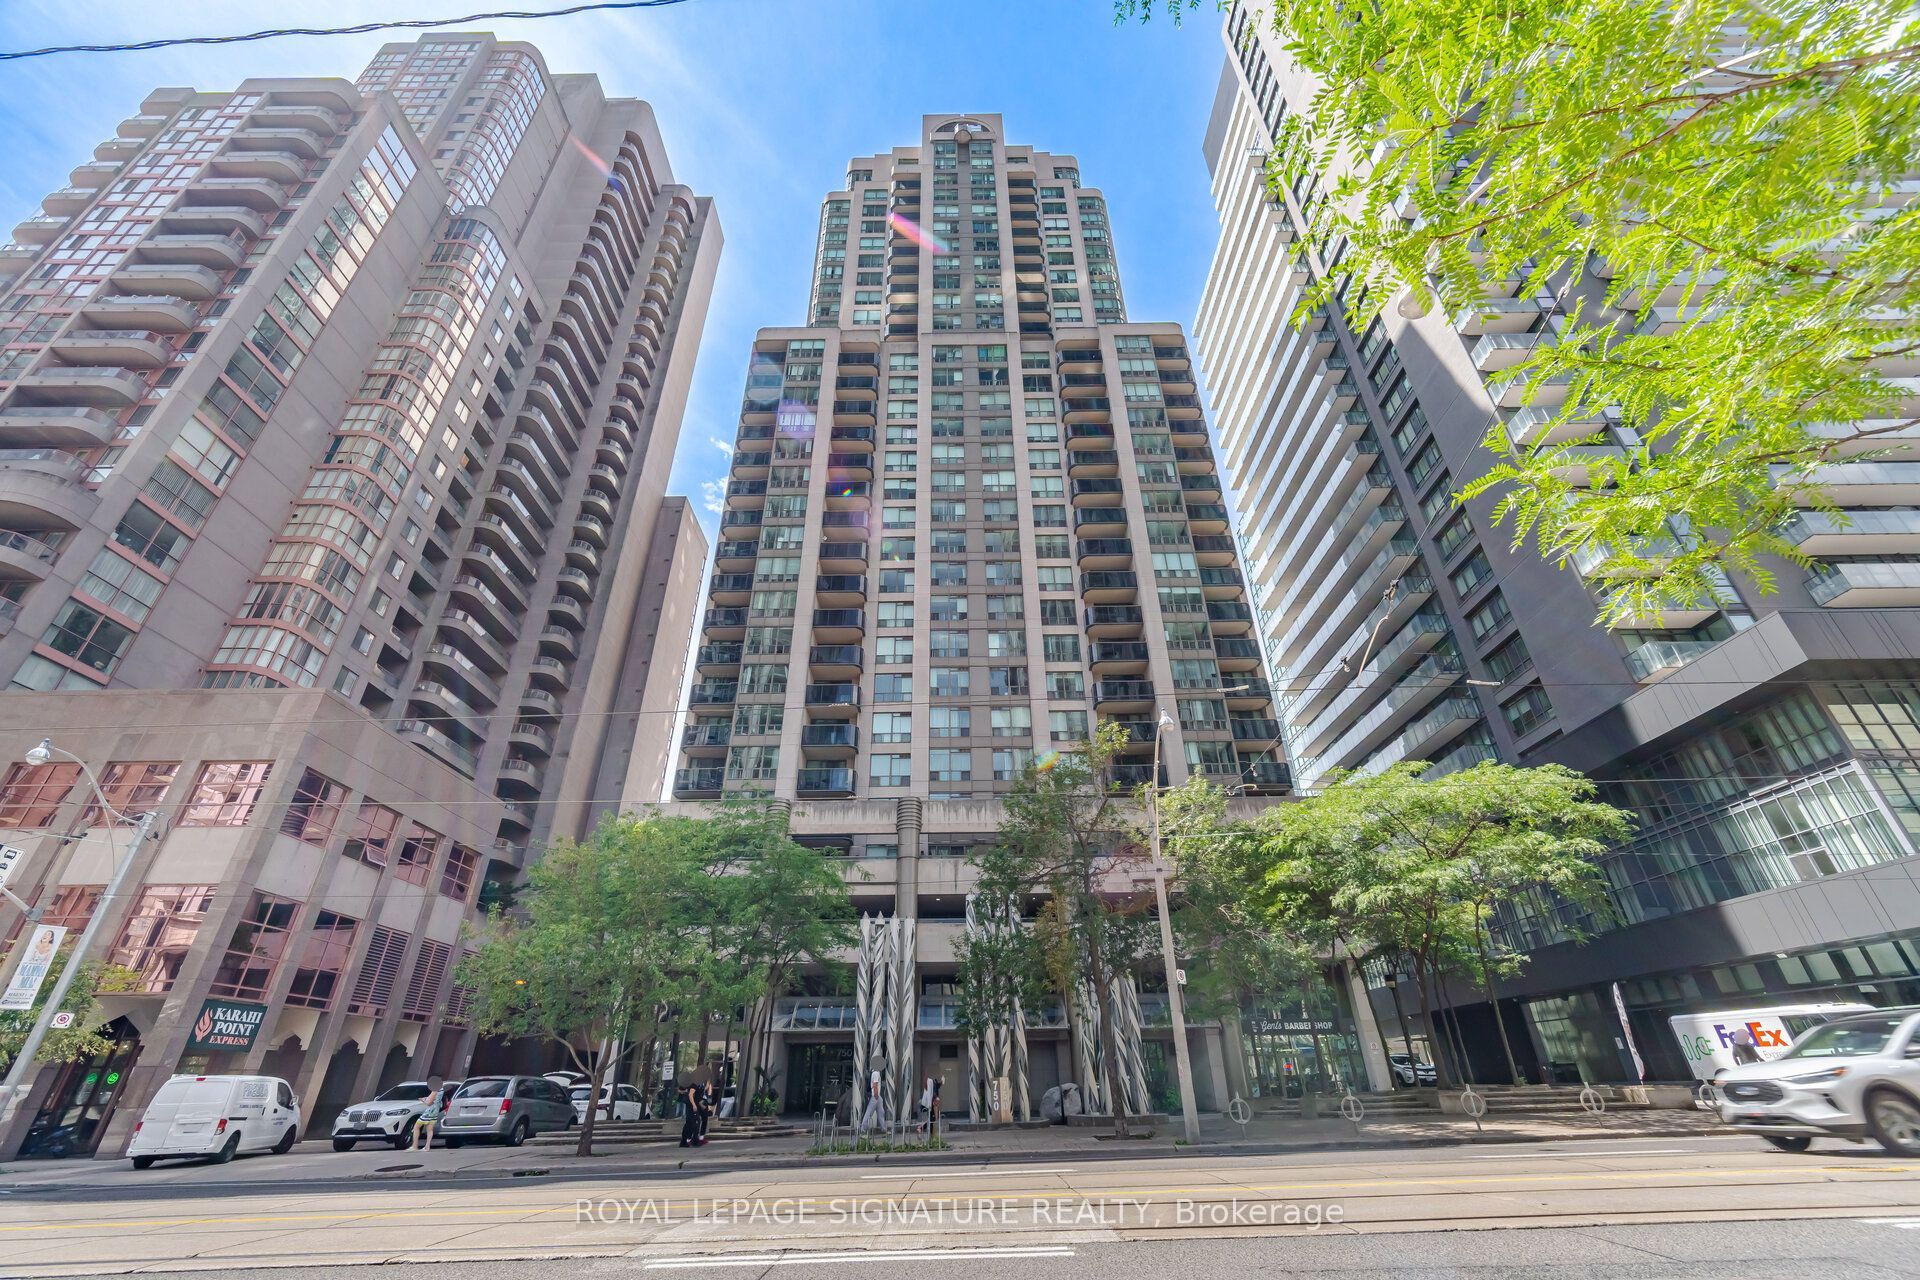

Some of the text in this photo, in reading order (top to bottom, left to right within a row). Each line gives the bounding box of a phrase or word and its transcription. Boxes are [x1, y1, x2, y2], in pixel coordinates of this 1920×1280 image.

[213, 1007, 263, 1024] KARAHI
[212, 1021, 255, 1036] POINT
[1259, 1020, 1283, 1033] Gents
[208, 1035, 250, 1046] EXPRESS
[992, 1080, 1000, 1112] 750
